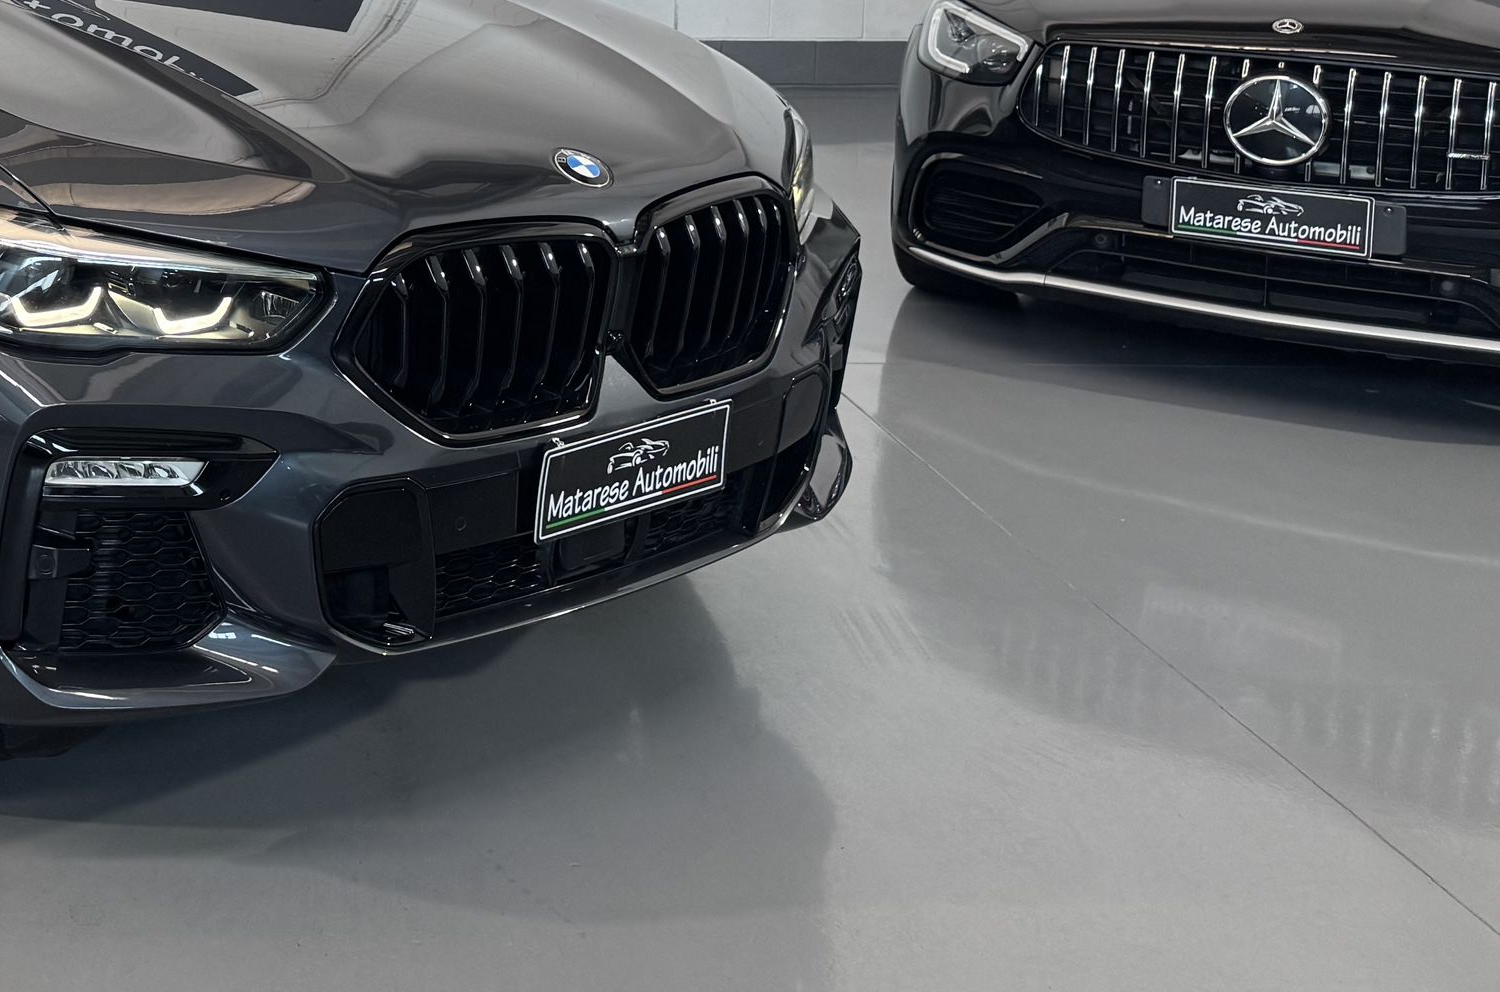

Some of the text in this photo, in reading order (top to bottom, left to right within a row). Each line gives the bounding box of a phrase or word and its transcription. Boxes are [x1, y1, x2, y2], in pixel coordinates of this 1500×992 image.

[1179, 205, 1362, 246] Matarese Automobili
[547, 445, 719, 522] Matarese Automobili
